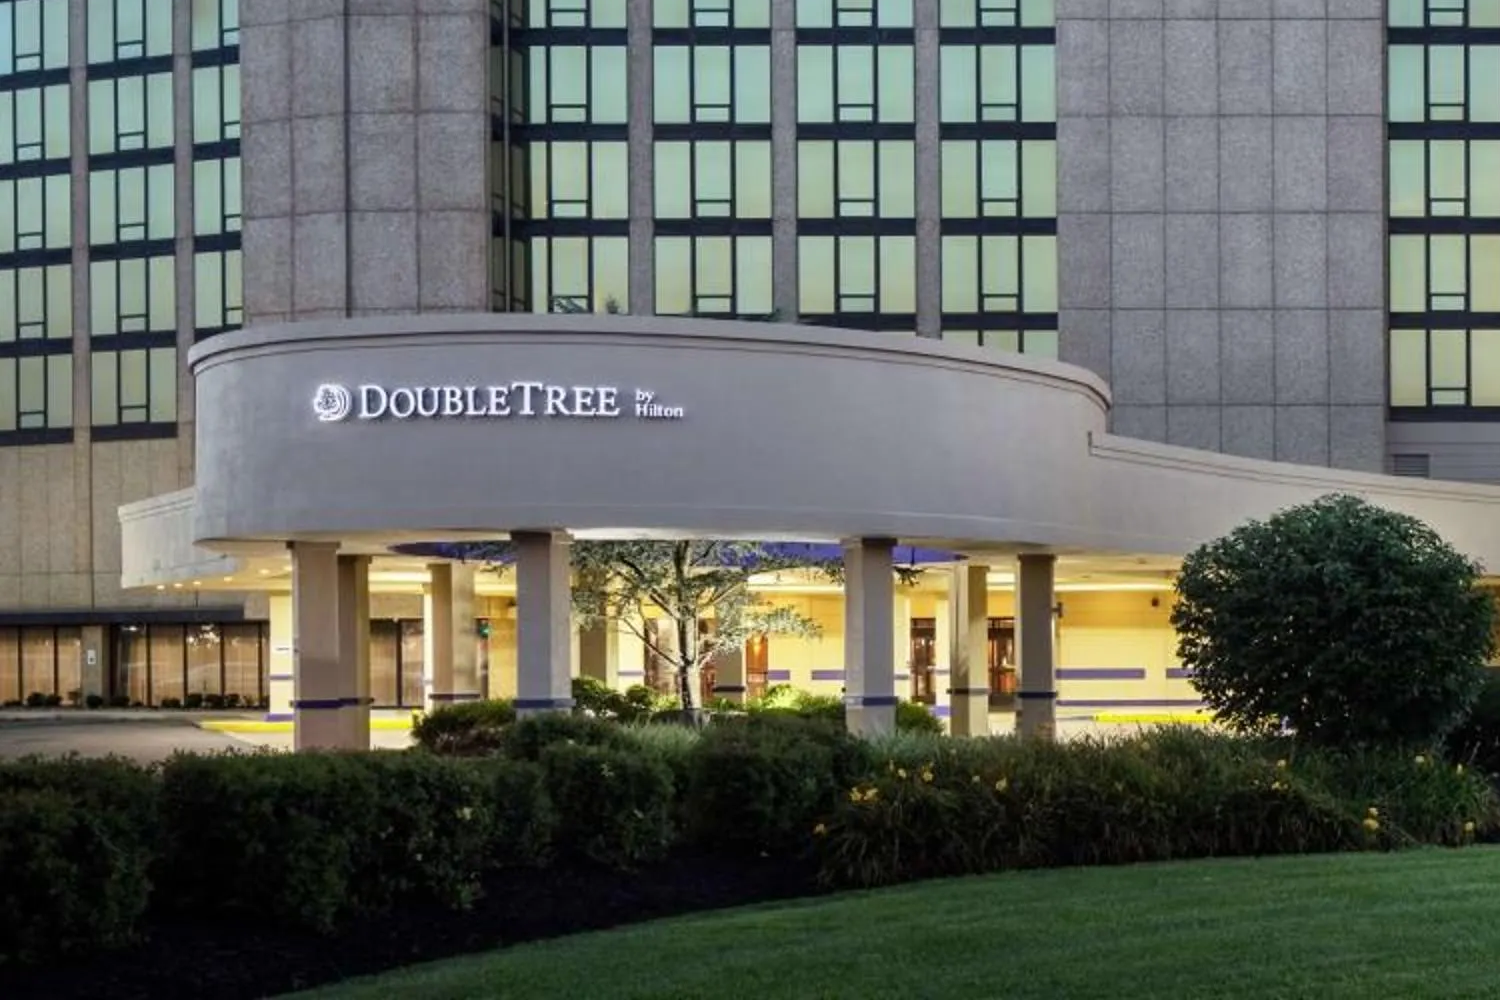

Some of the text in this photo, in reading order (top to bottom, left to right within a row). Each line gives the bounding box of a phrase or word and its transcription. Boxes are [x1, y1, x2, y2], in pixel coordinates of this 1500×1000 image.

[358, 382, 620, 417] DOUBLETREE
[635, 388, 655, 403] by
[635, 403, 684, 418] Hilton
